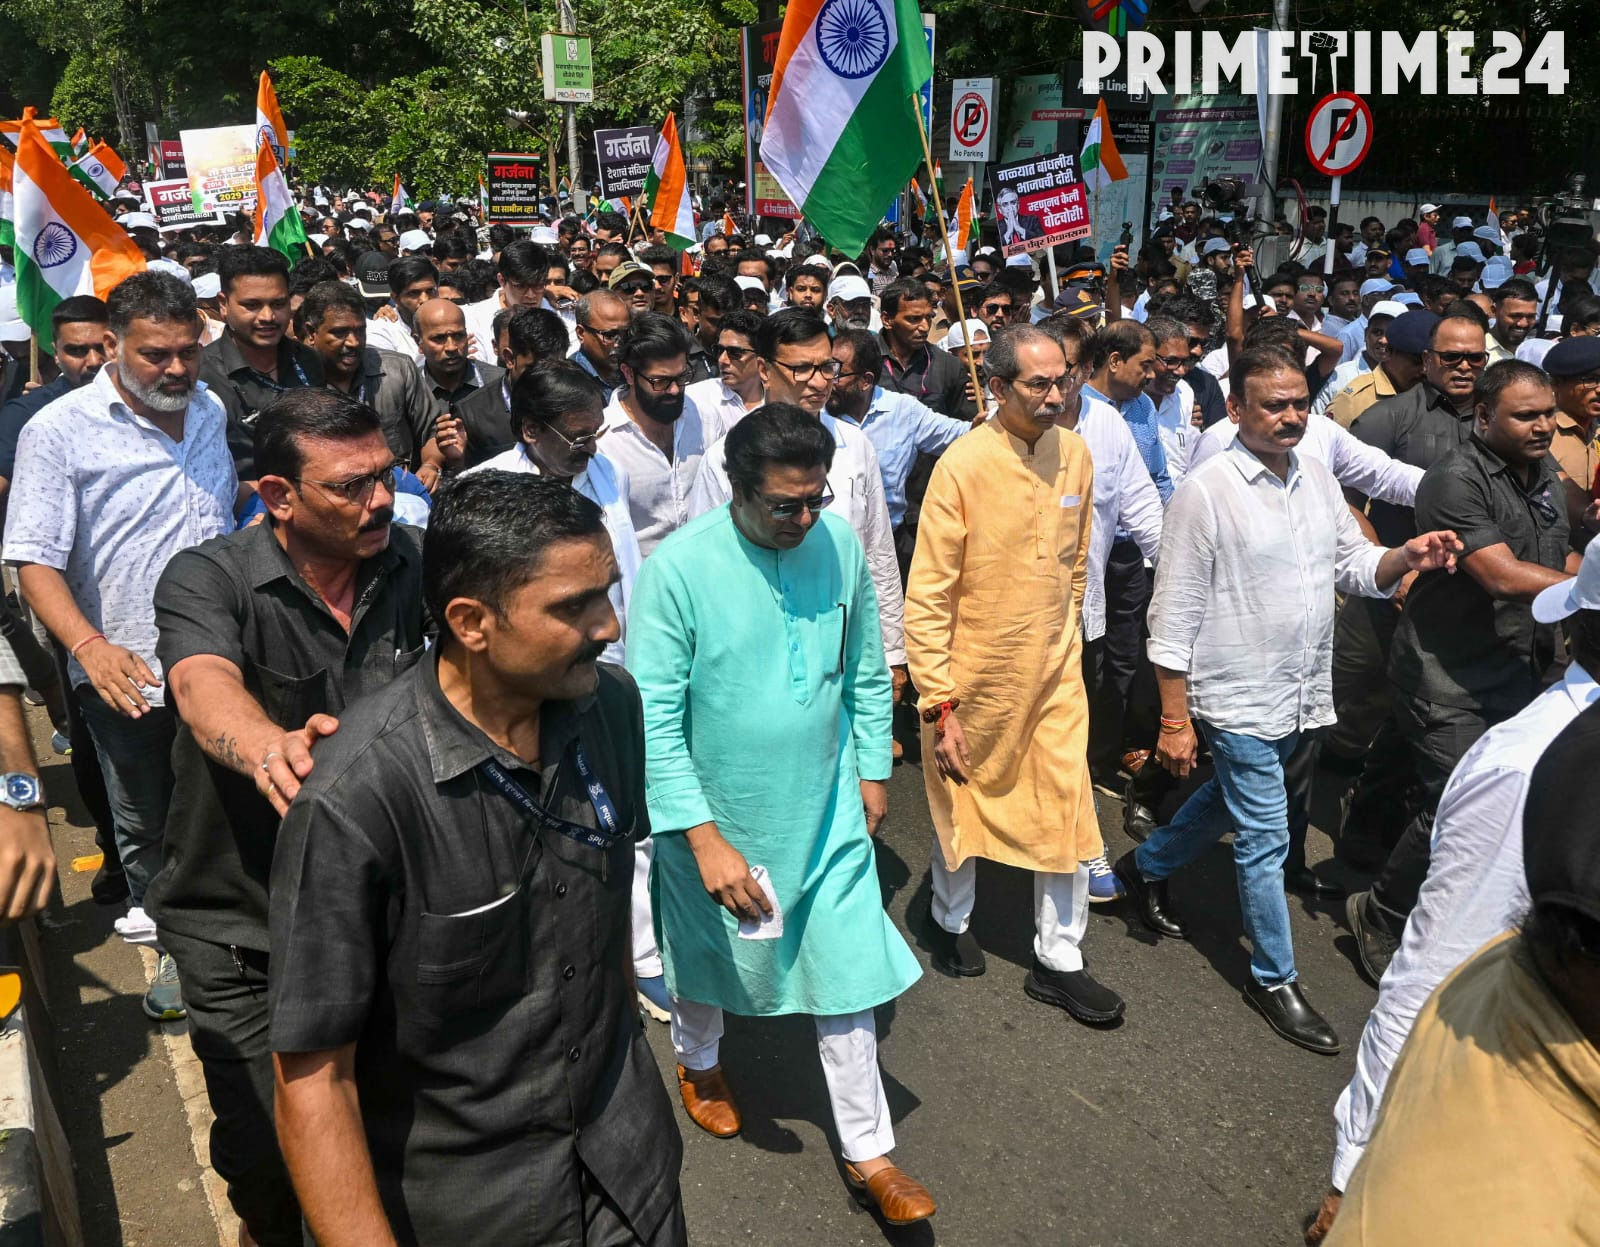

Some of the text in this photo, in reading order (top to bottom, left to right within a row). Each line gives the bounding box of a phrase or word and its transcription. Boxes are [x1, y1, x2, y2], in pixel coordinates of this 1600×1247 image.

[1106, 79, 1127, 91] Line
[604, 132, 651, 159] गर्जना
[963, 150, 984, 158] Parking
[493, 163, 535, 179] गर्जना
[627, 163, 651, 176] संविधा
[997, 154, 1074, 181] गळ्यात बांधलीय
[607, 178, 645, 192] वाचविण्या
[1017, 174, 1054, 193] भाजपची
[219, 192, 242, 201] 2029
[1027, 188, 1080, 212] म्हणूनच केली
[1043, 205, 1084, 228] वोटचोरी!
